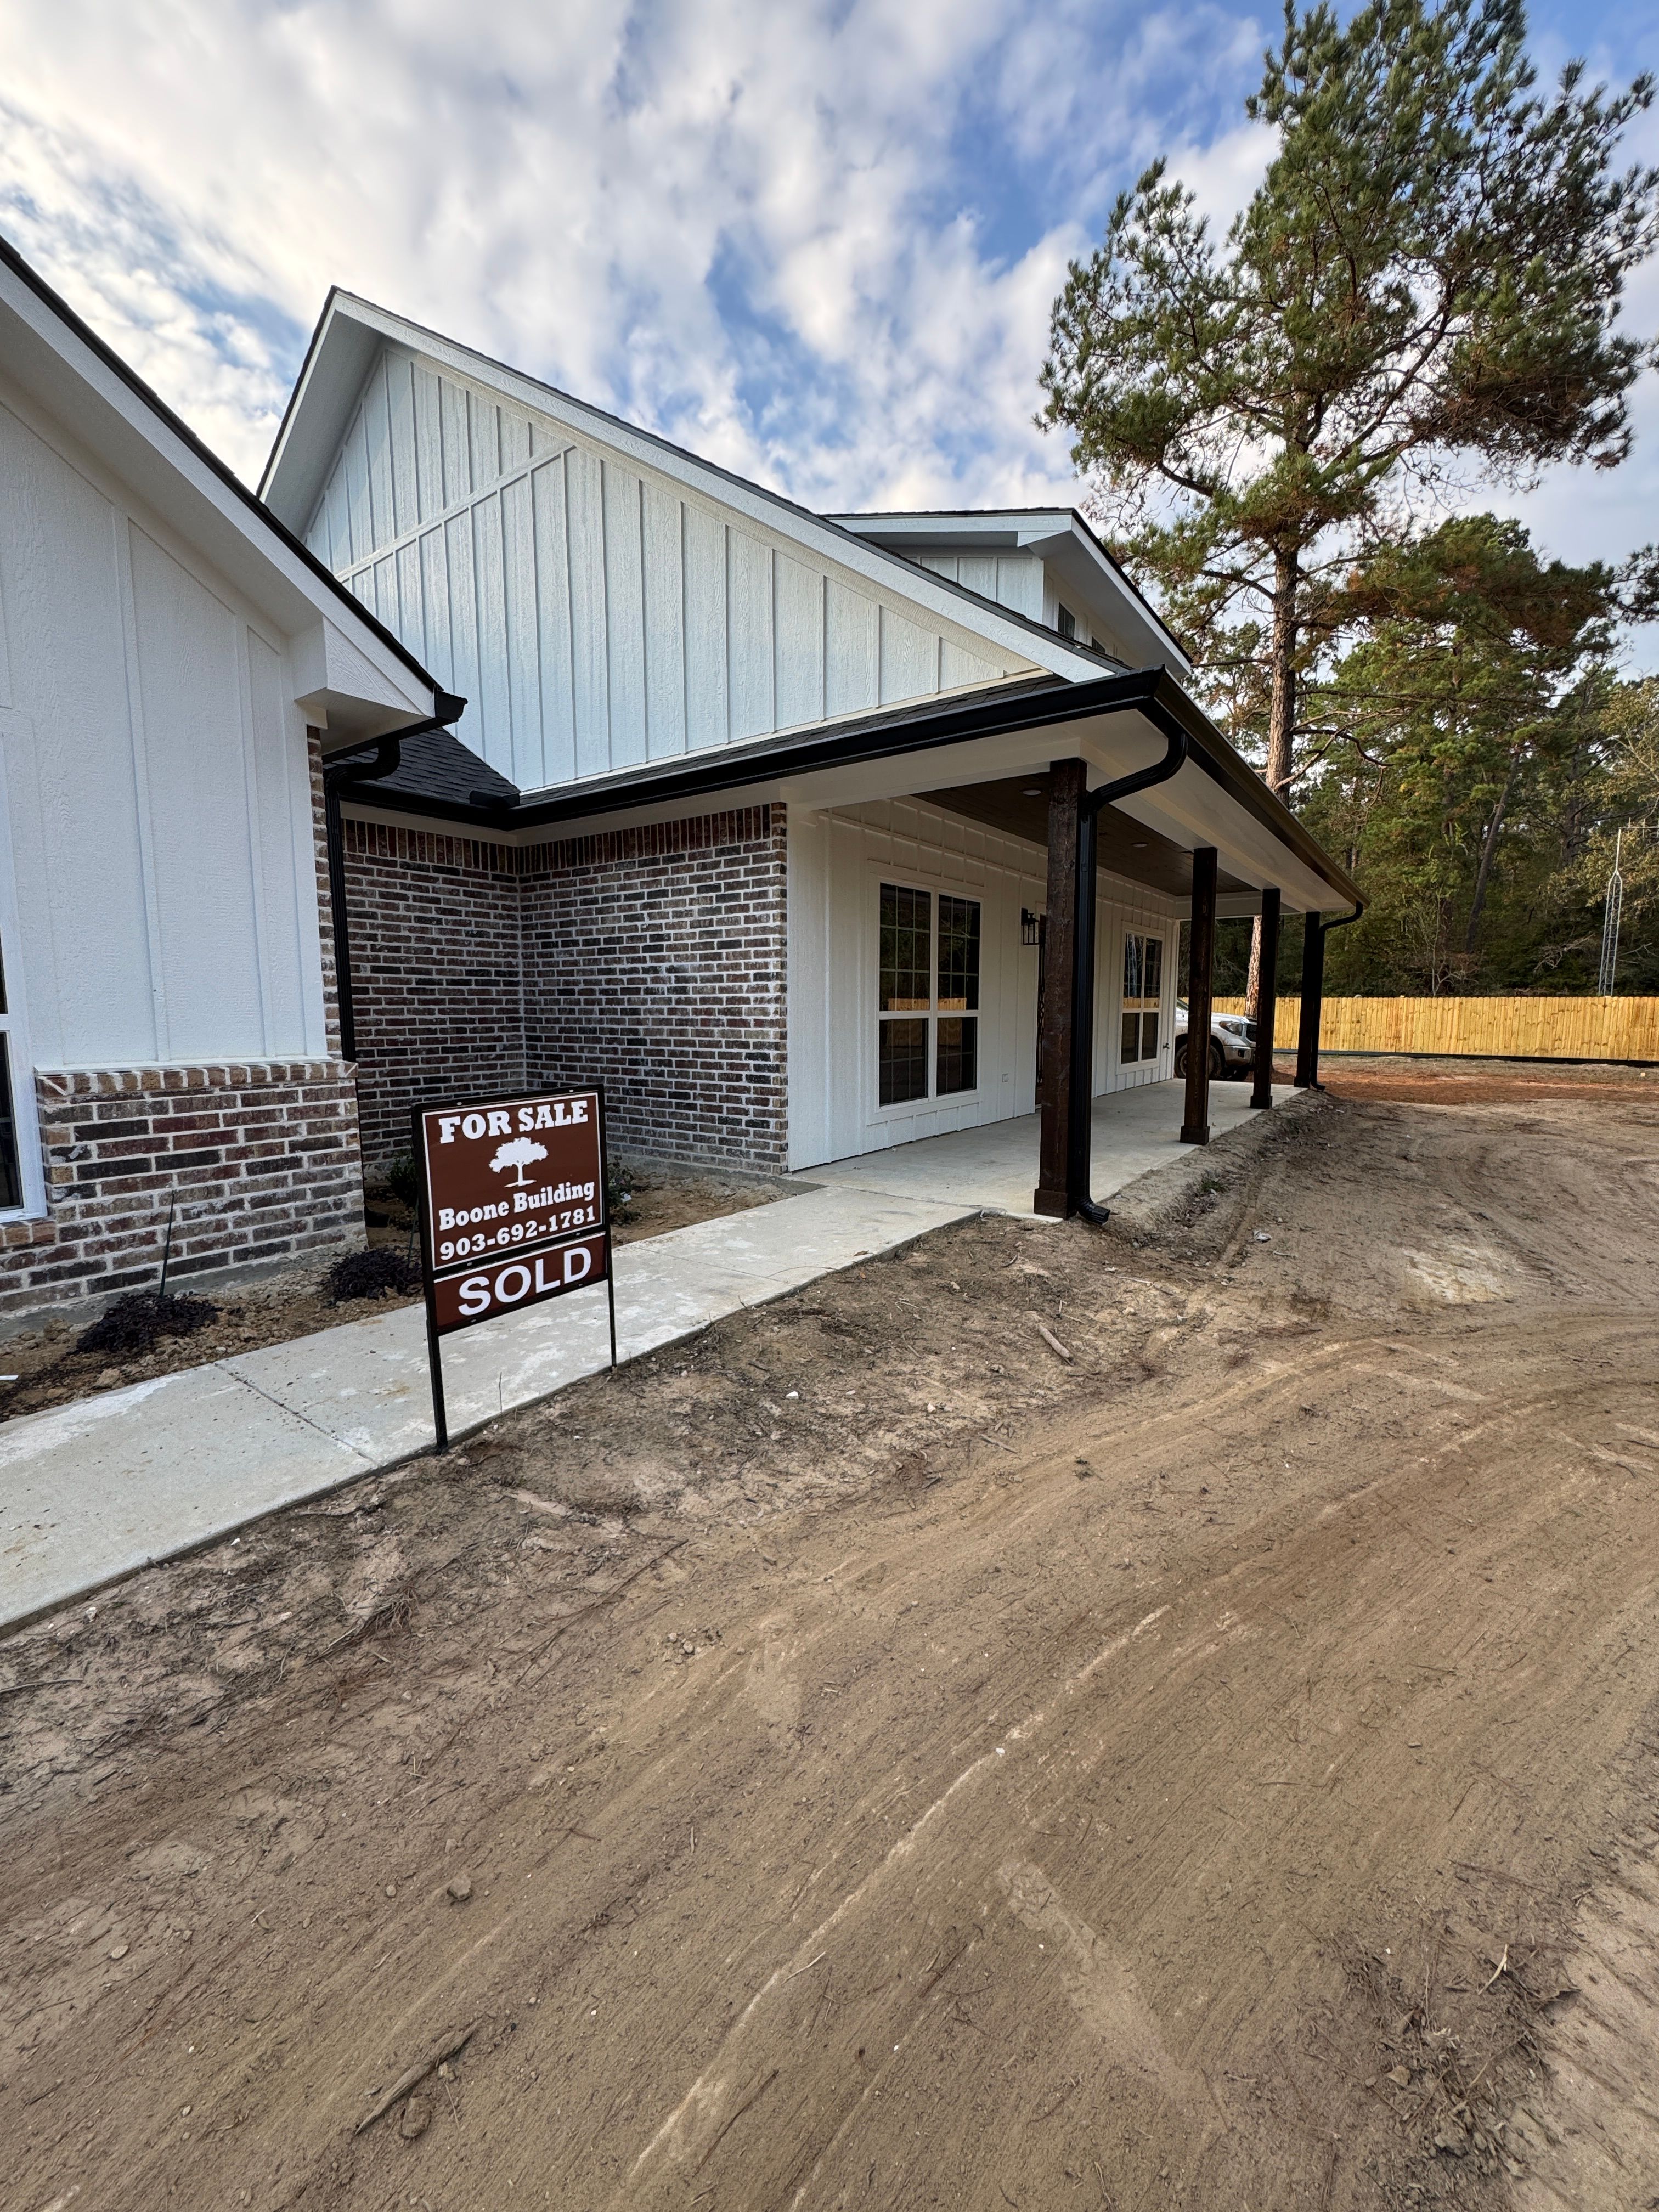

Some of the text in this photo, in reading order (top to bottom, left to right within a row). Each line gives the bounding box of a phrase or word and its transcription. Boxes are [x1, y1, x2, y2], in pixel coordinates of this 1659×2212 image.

[439, 1101, 588, 1143] FOR SALE
[439, 1182, 594, 1231] Boone Building
[440, 1206, 595, 1260] 903-692-1781
[459, 1248, 591, 1315] SOLD
